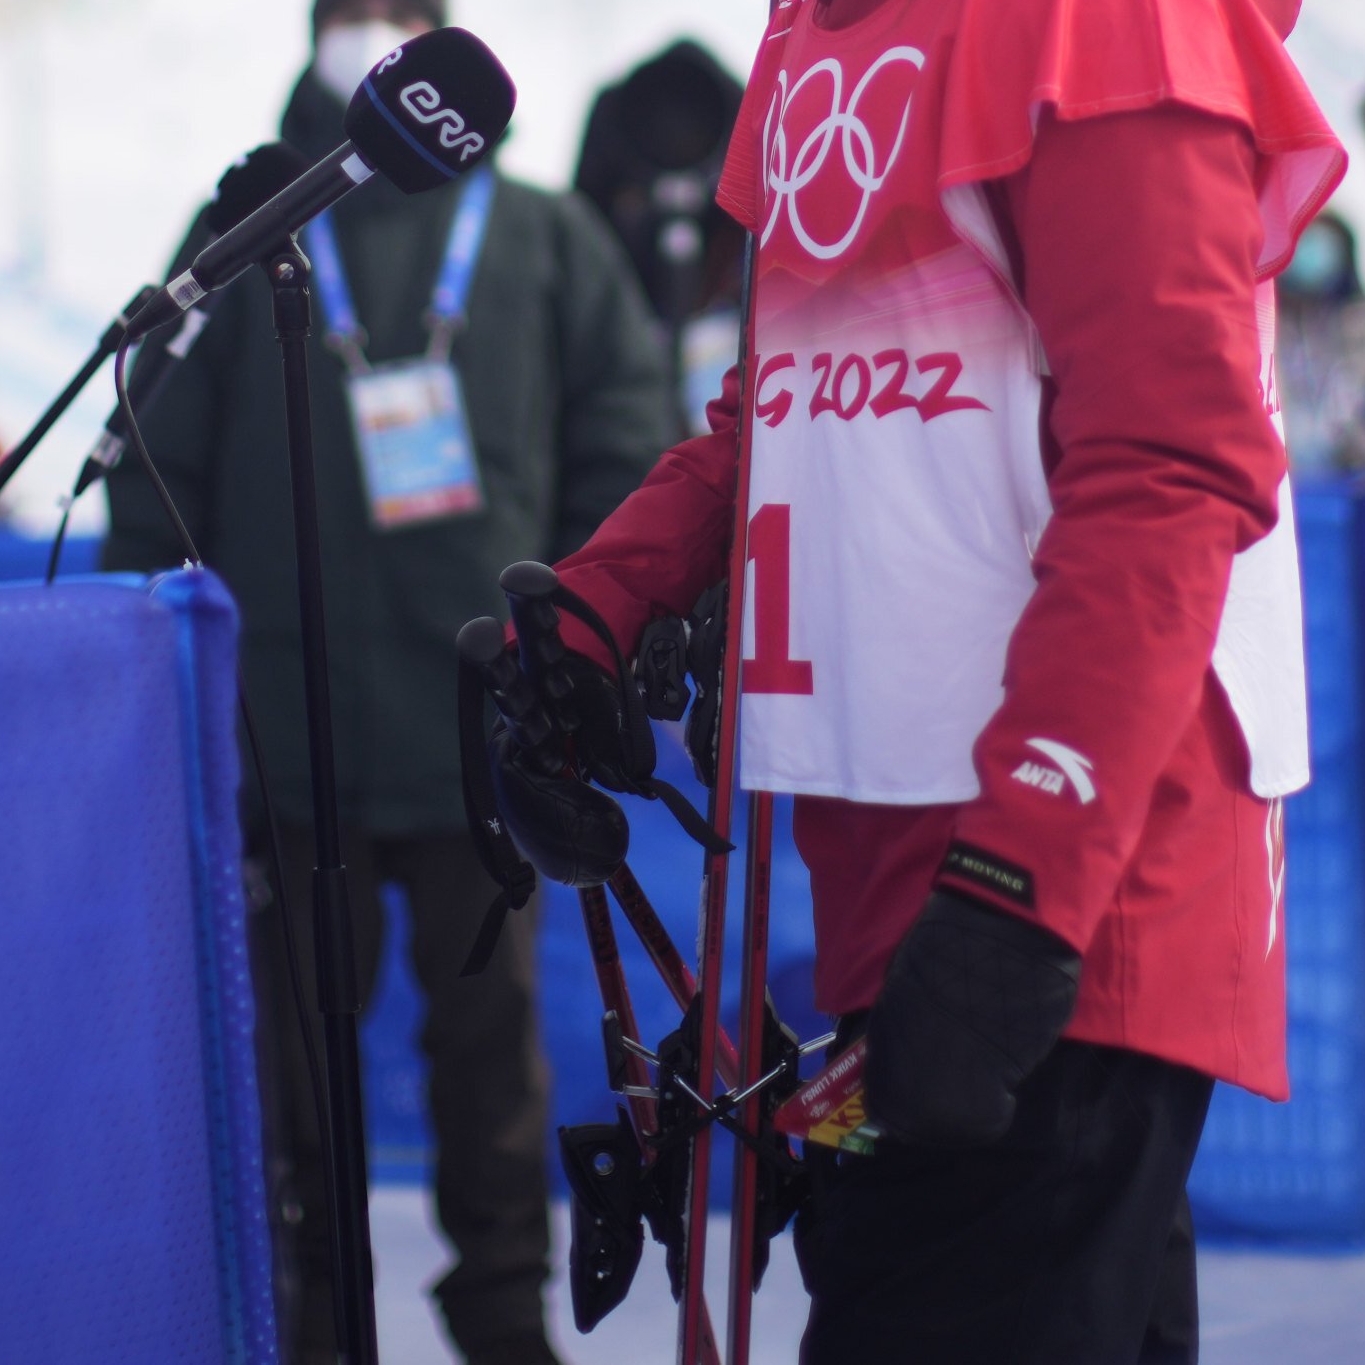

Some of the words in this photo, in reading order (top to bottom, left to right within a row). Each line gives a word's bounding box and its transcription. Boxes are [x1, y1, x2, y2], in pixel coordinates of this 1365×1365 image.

[808, 347, 994, 424] 2022
[1010, 760, 1065, 796] ANTA
[829, 1052, 858, 1082] KVIKK
